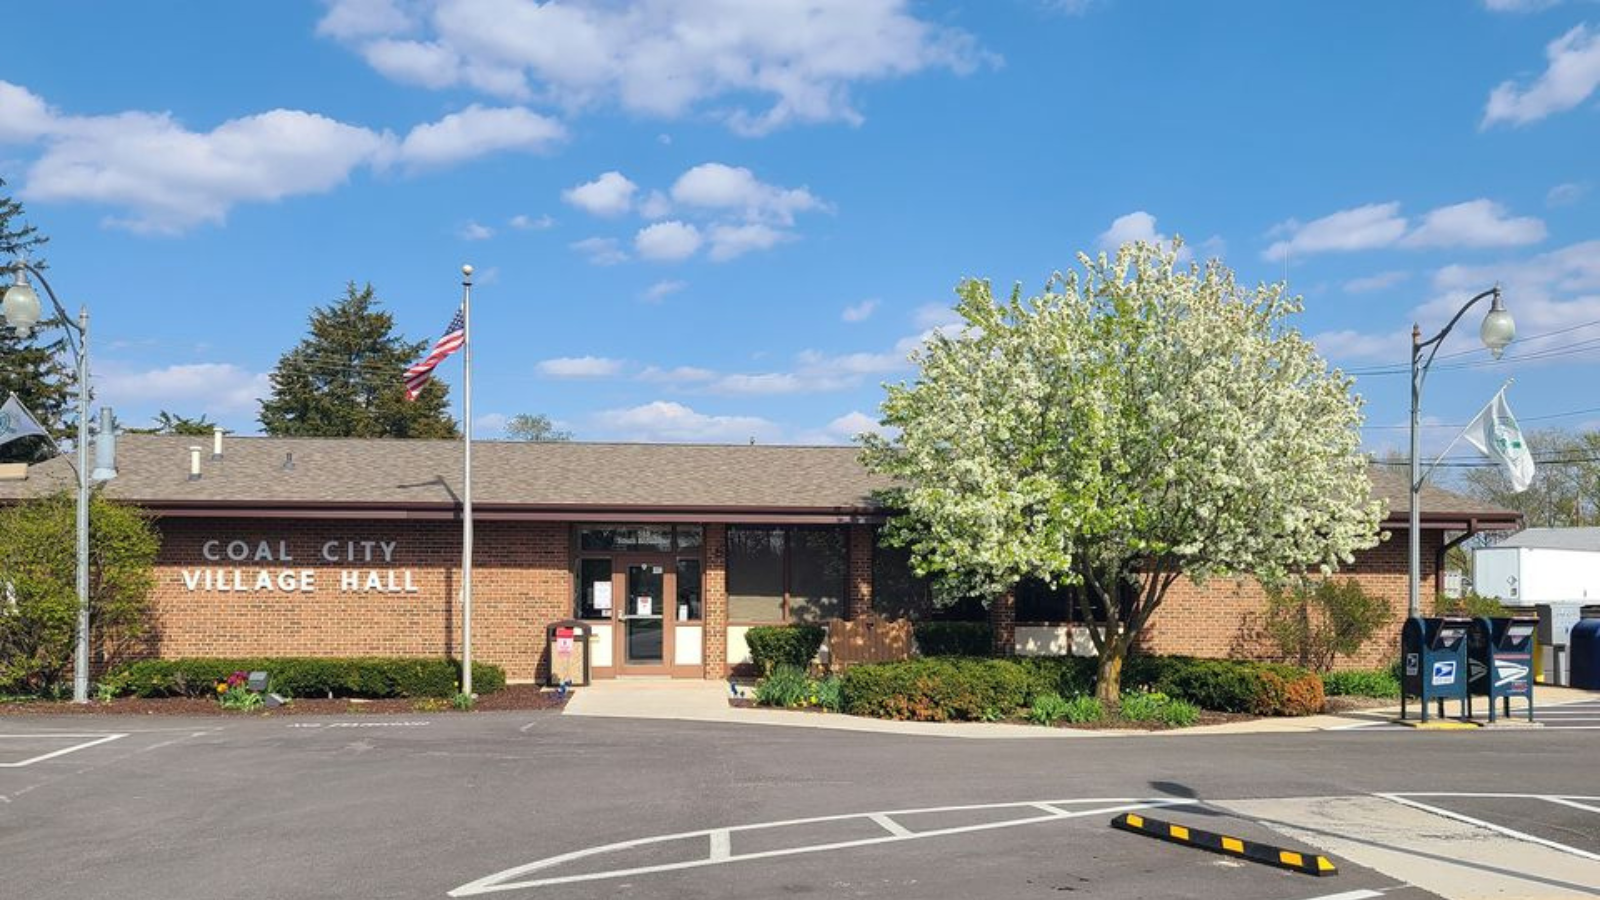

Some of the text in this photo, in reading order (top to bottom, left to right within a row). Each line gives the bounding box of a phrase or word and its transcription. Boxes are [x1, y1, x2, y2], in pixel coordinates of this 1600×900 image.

[203, 540, 397, 561] COAL CITY
[182, 570, 418, 592] VILLAGE HALL
